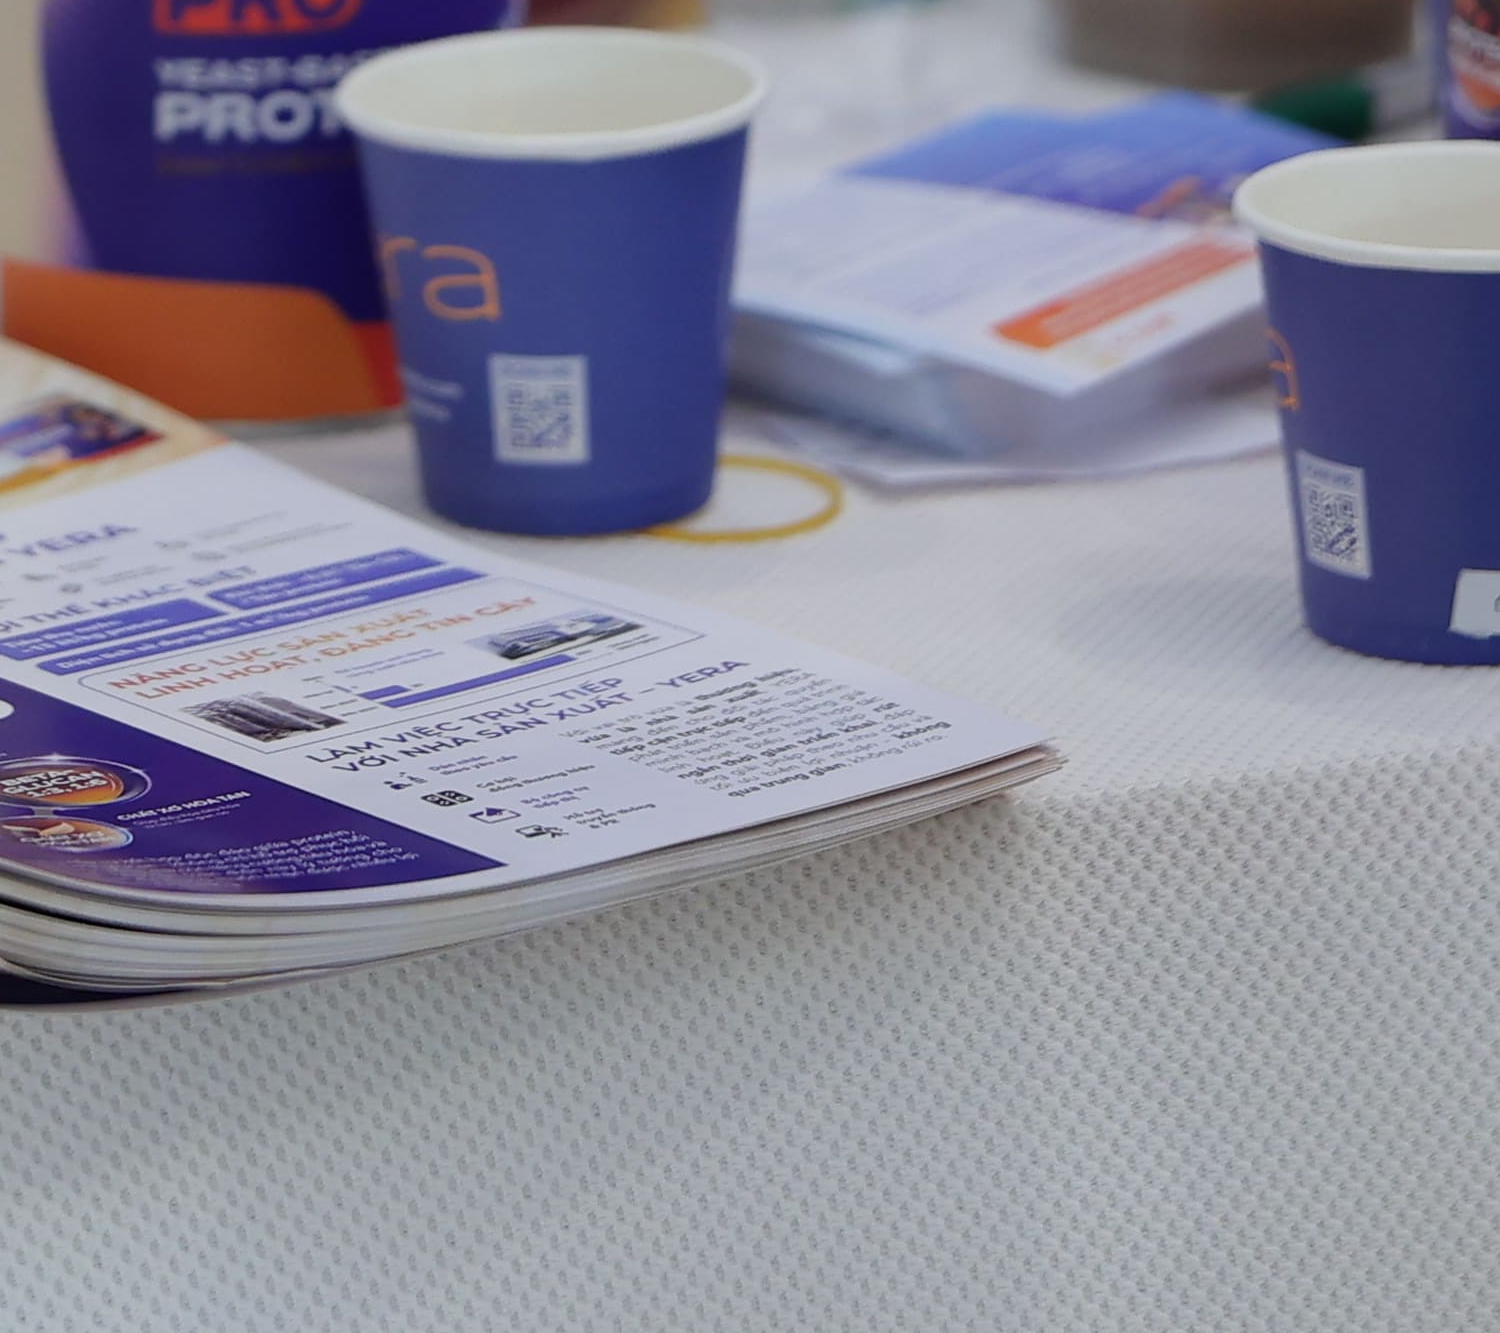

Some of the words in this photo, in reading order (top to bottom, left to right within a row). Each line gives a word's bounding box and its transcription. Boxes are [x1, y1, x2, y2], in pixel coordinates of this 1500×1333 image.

[154, 89, 346, 142] PROT
[4, 524, 139, 557] YERA
[207, 648, 279, 673] LỰC
[136, 676, 221, 700] LINH
[305, 740, 384, 763] LÀM
[379, 721, 464, 744] VIỆC
[458, 698, 555, 725] TRỰC
[549, 677, 623, 700] TIẾP
[331, 754, 400, 772] VỚI
[397, 736, 479, 758] NHÀ
[475, 717, 549, 740] SẢN
[545, 692, 633, 721] XUẤT
[656, 659, 750, 689] YERA
[891, 721, 952, 740] không
[609, 744, 646, 756] tiếp
[646, 735, 679, 746] cận
[675, 725, 714, 738] trực
[710, 716, 747, 728] tiếp
[677, 765, 722, 780] ngắn
[720, 753, 759, 767] thời
[759, 743, 799, 758] gian
[796, 732, 840, 746] triển
[3, 771, 107, 794] GLUCAN
[727, 786, 761, 798] qua
[759, 772, 811, 788] trung
